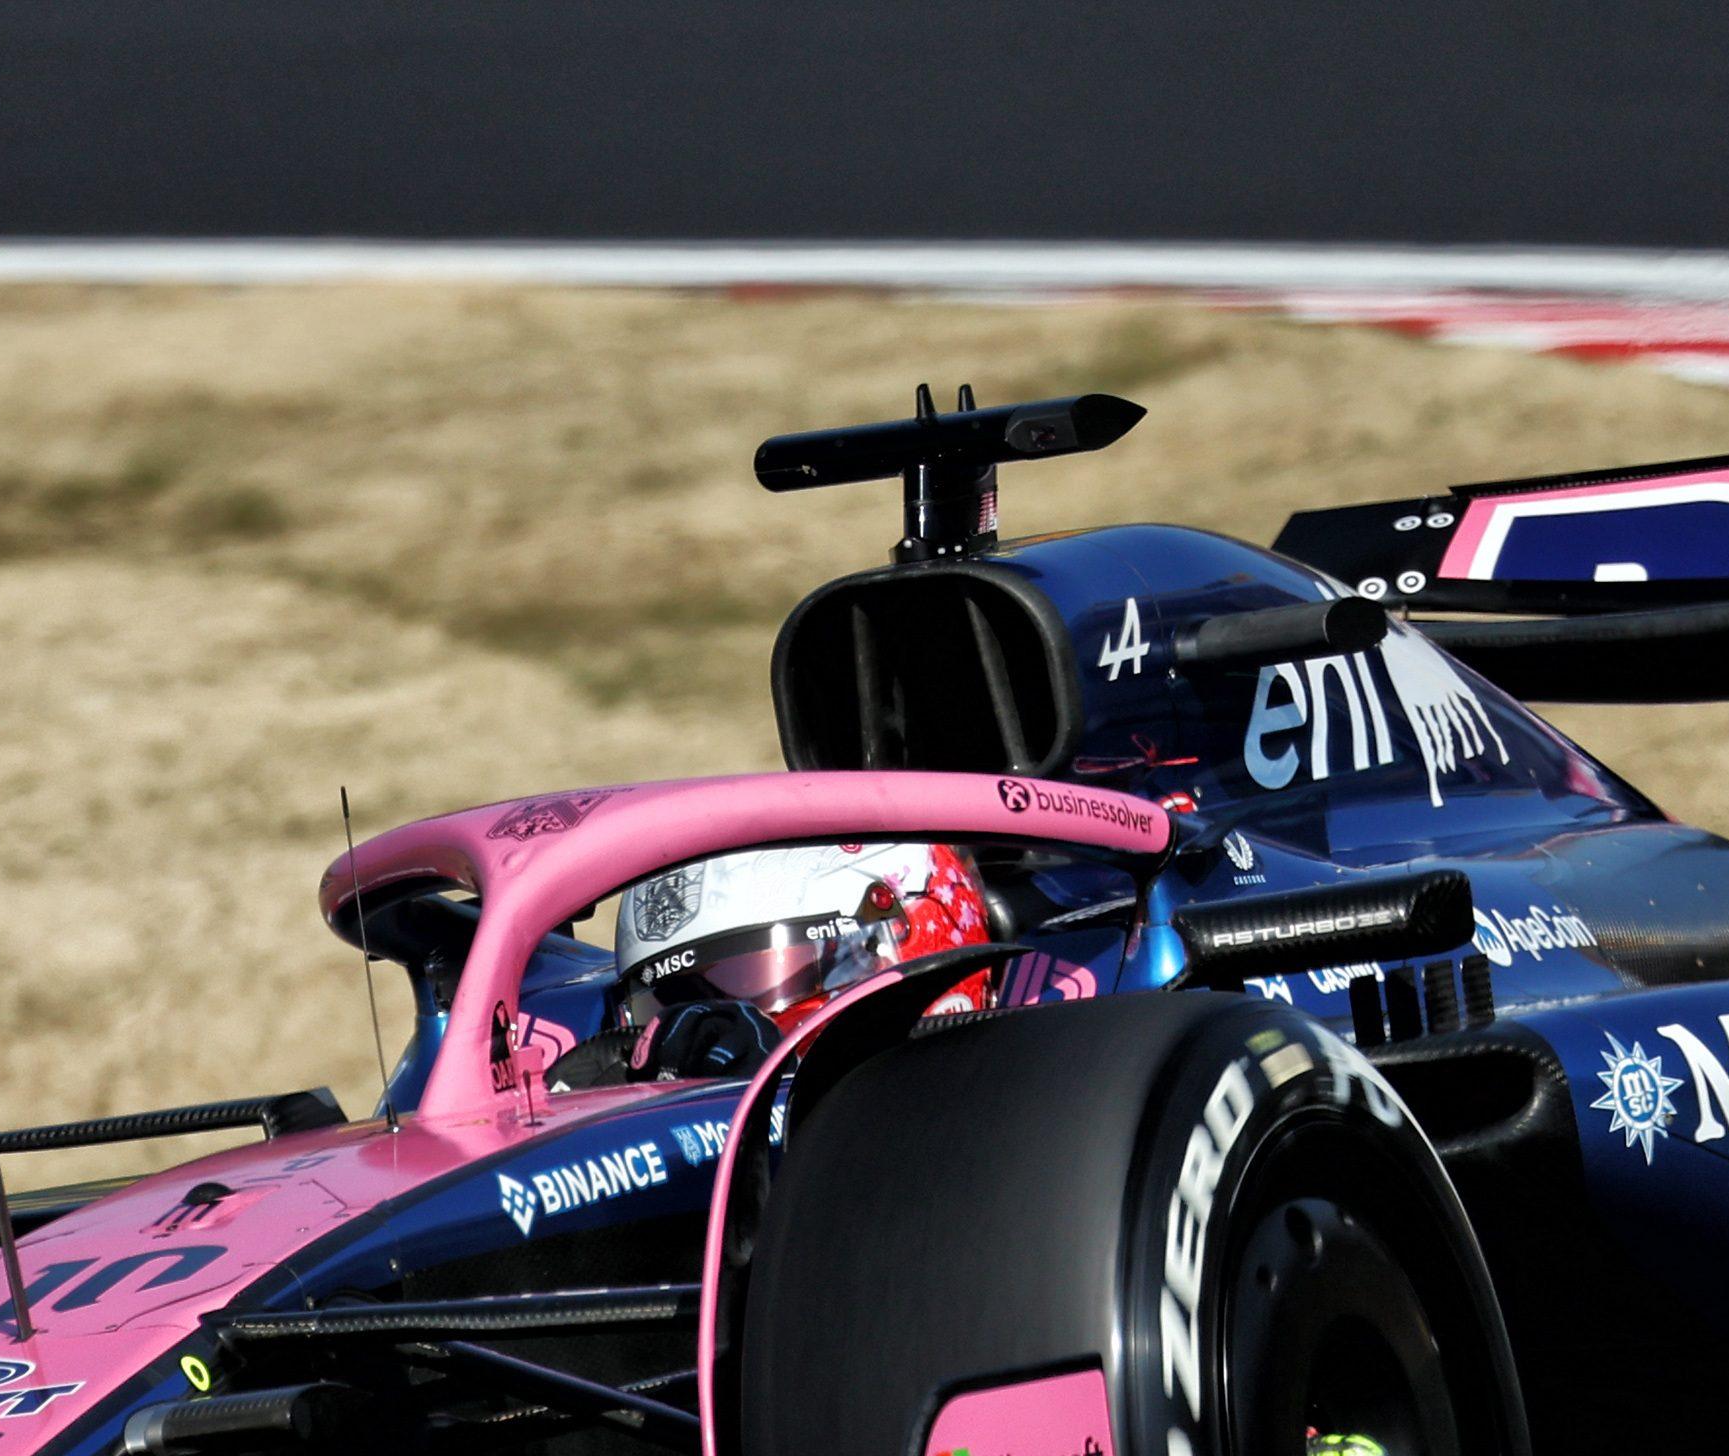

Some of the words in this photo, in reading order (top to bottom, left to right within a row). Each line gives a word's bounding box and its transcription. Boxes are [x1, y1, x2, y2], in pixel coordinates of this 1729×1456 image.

[1244, 648, 1393, 790] eni
[1036, 779, 1154, 835] businessolver
[806, 919, 836, 940] eni
[1490, 905, 1598, 961] ApeCoin
[653, 949, 696, 980] MSC
[532, 1142, 668, 1214] BINANCE
[1159, 1057, 1255, 1424] ZERO
